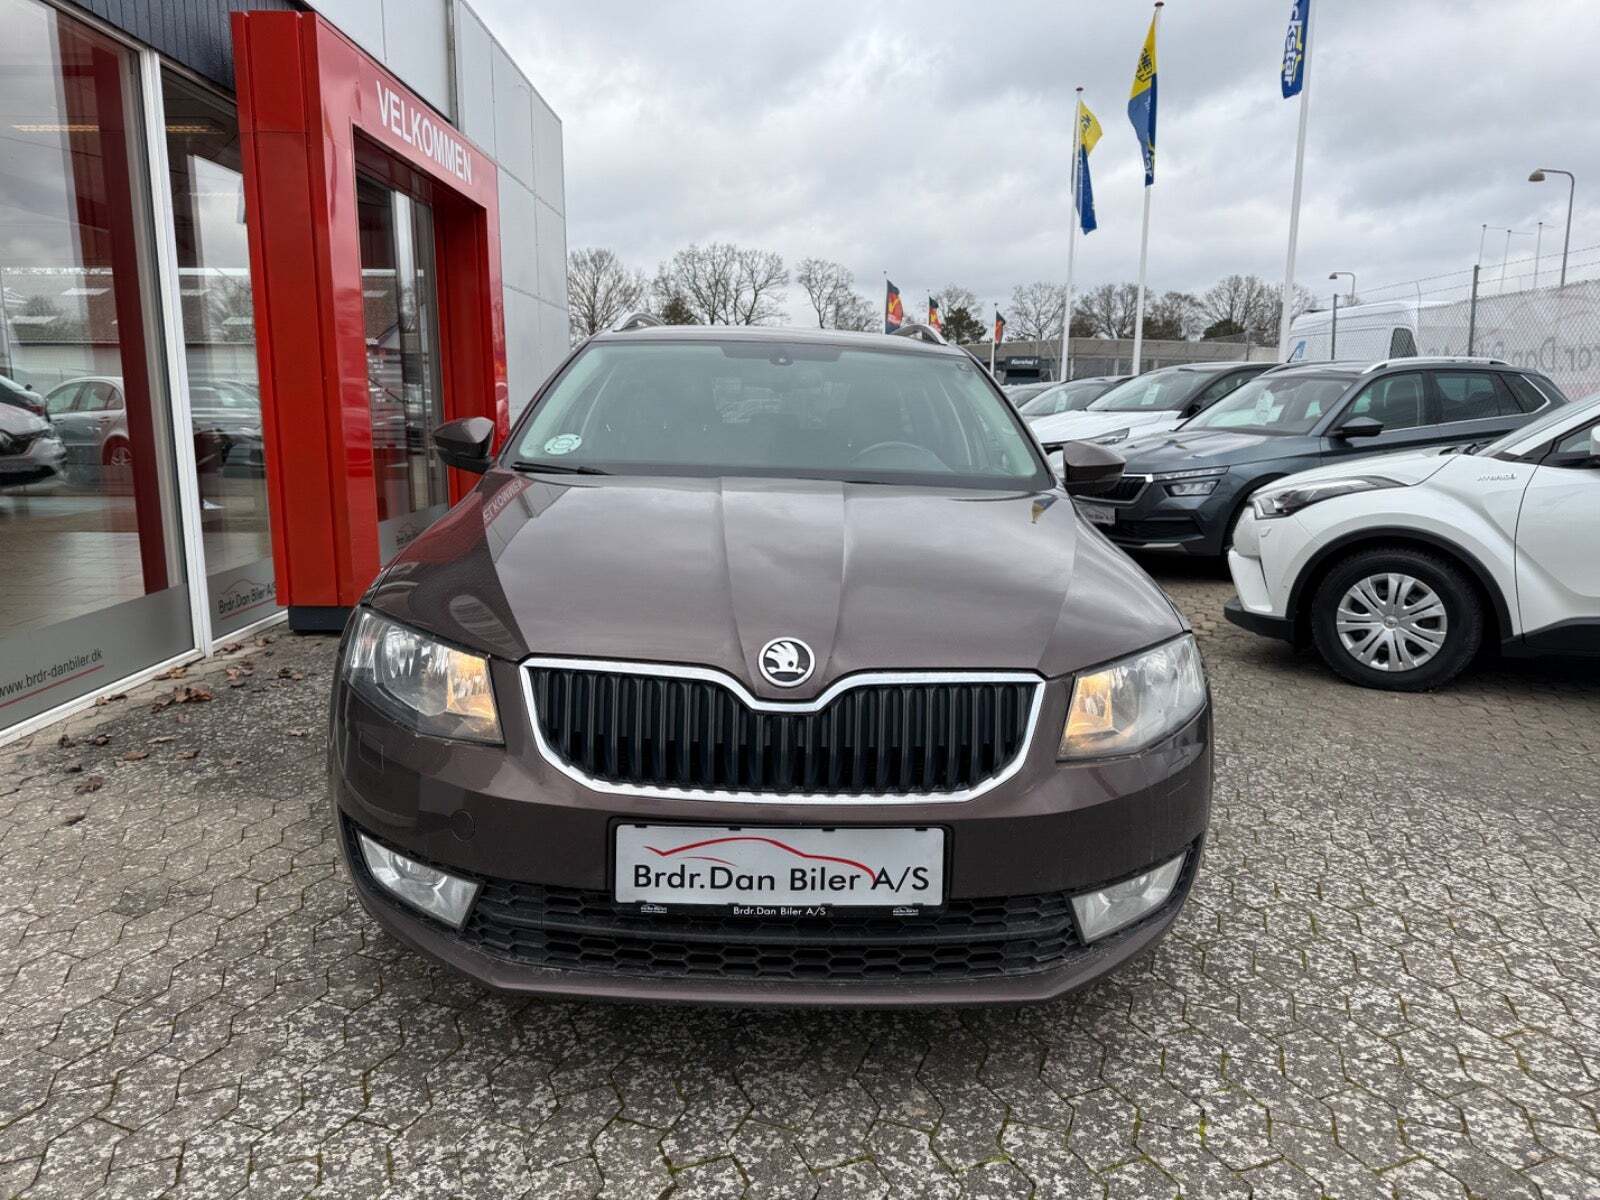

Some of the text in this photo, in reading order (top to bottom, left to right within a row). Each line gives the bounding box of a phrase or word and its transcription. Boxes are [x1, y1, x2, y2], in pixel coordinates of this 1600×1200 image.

[376, 80, 472, 185] VELKOMMEN
[633, 864, 929, 893] Brdr.Dan Biler A/S
[733, 906, 826, 917] Brdr.Dan Biler A/S
